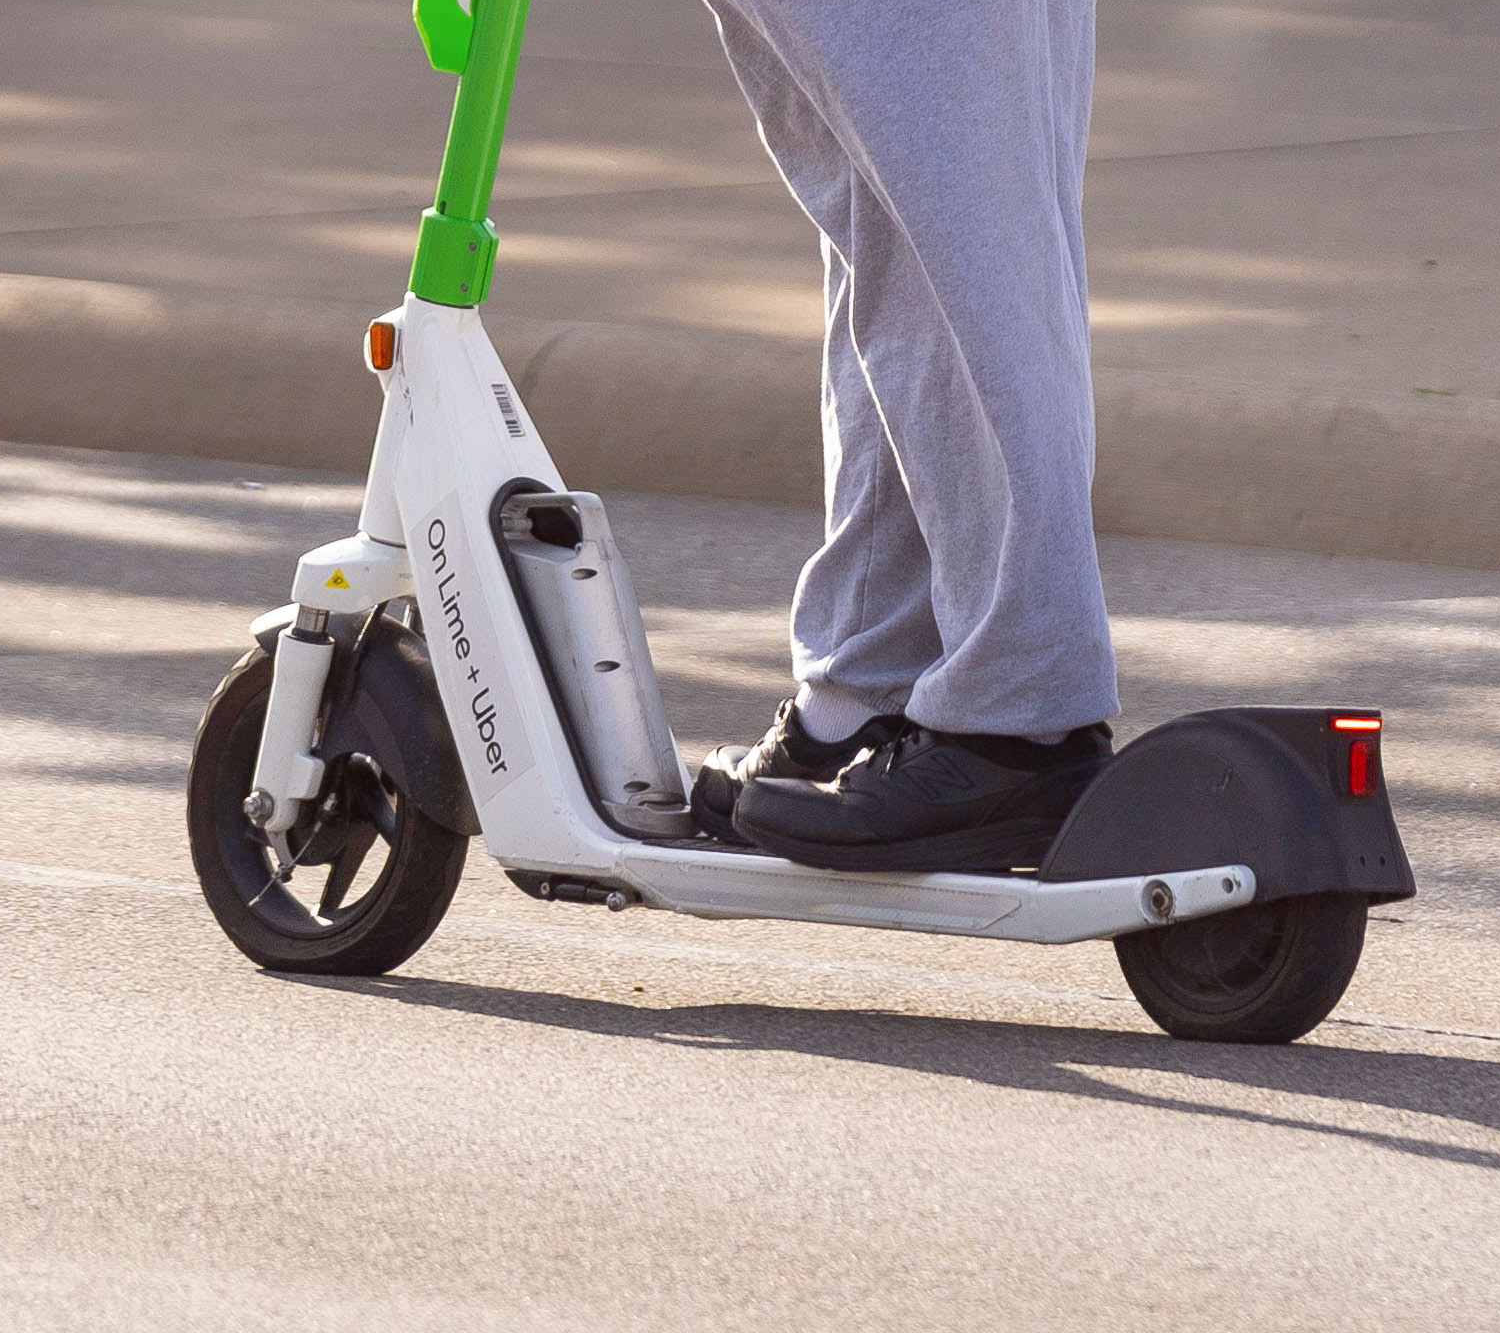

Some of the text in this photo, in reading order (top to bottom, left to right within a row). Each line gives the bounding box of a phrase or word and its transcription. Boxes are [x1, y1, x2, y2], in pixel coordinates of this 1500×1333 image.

[428, 518, 508, 775] On Lime + Uber
